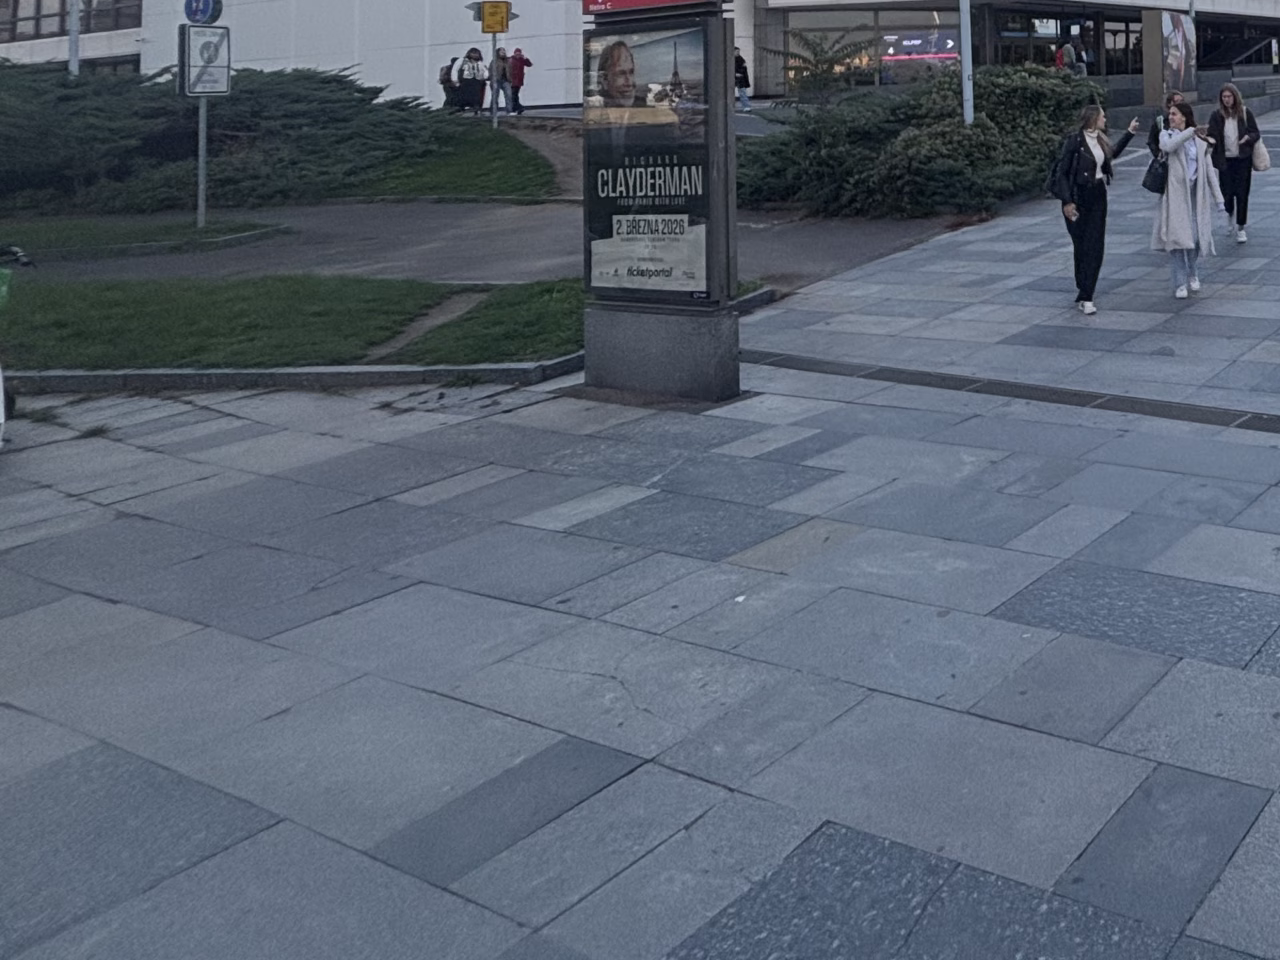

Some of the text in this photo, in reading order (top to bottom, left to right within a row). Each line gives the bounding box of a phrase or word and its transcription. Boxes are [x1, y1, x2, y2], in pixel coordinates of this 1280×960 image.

[597, 165, 703, 198] CLAYDERMAN
[615, 216, 685, 235] 2. BŘEZNA 2026
[626, 266, 673, 280] ticketportal
